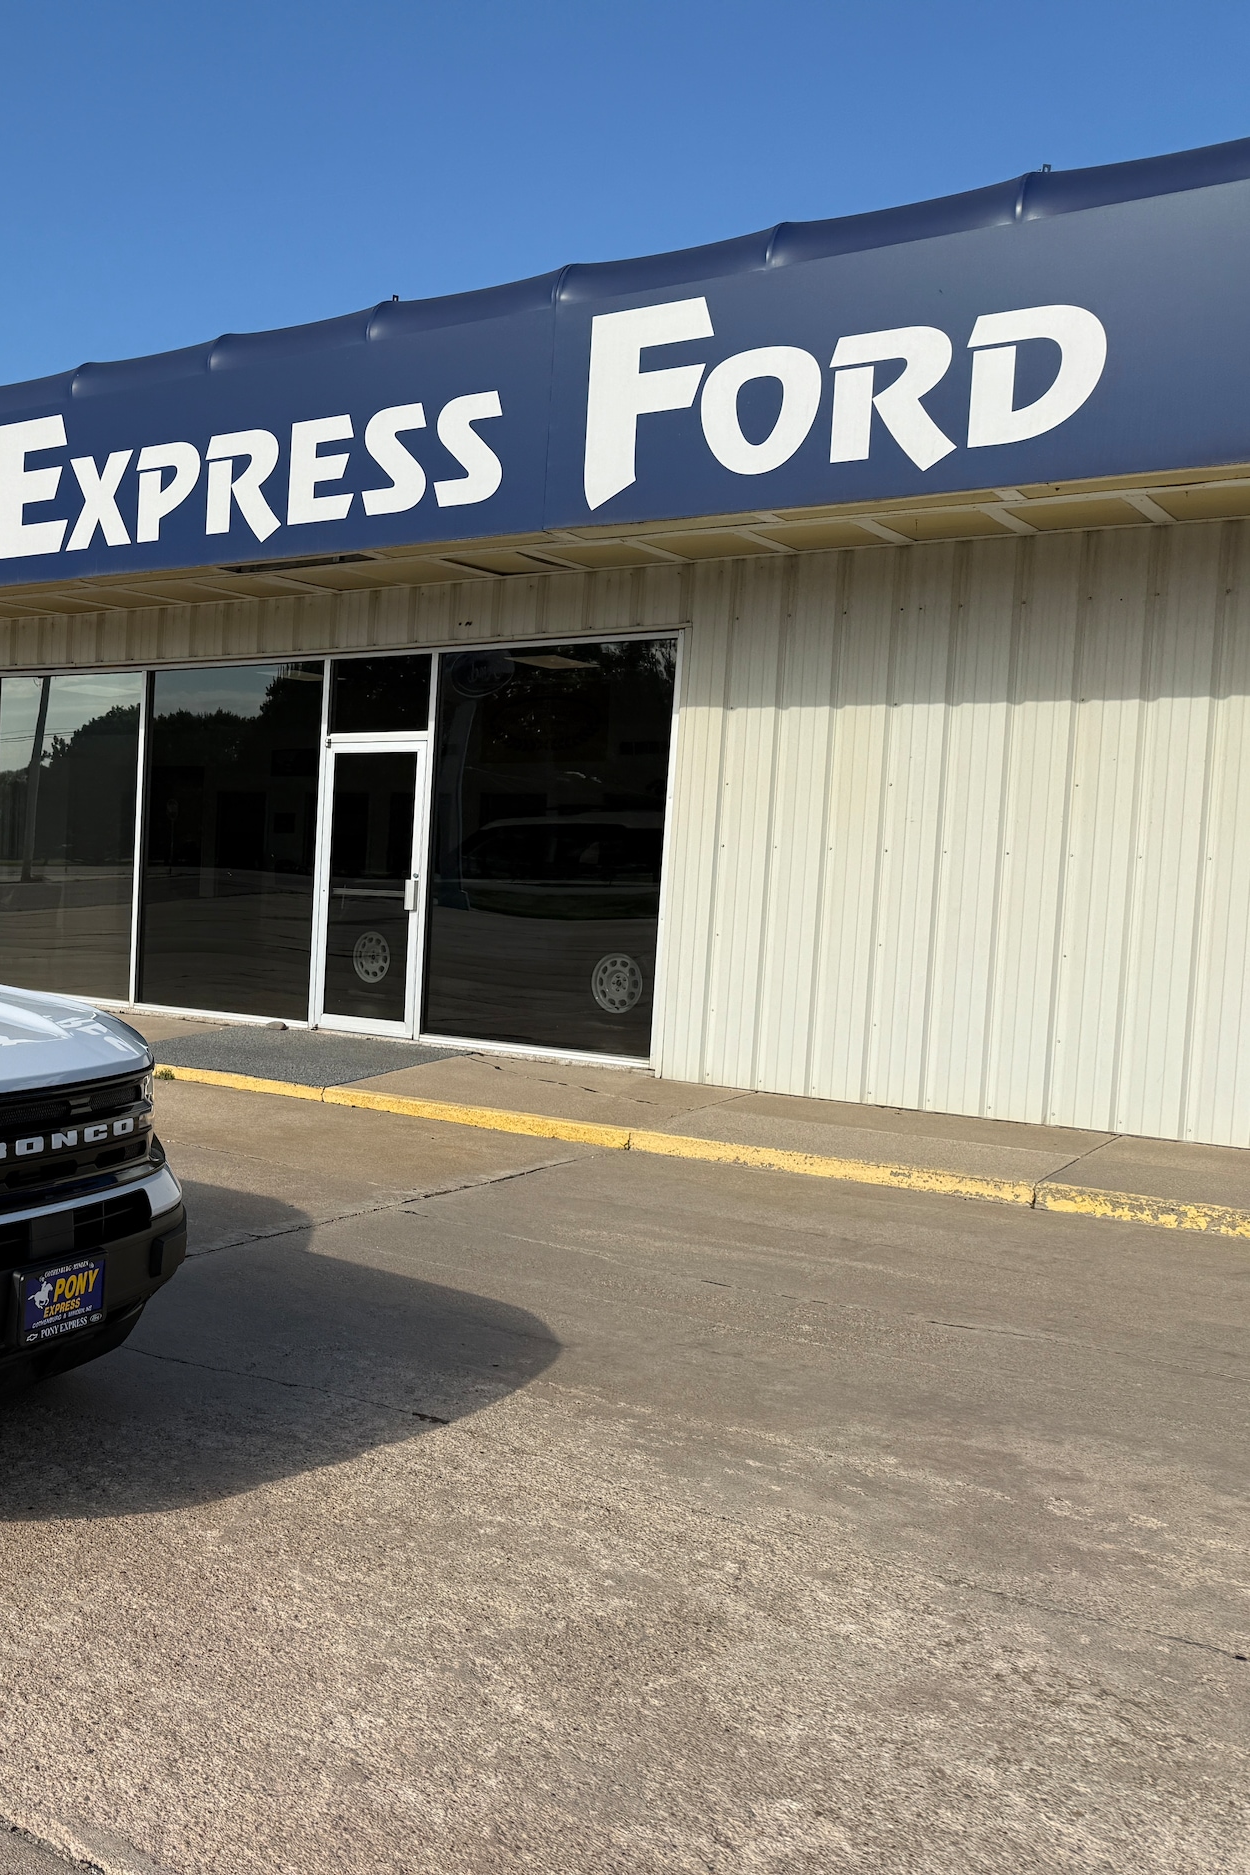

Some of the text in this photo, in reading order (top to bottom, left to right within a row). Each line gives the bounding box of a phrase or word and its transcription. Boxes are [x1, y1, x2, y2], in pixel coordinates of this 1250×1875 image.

[583, 296, 1107, 512] FORD
[53, 1268, 100, 1302] PONY
[43, 1297, 81, 1319] EXPRESS
[40, 1324, 60, 1339] PONY
[59, 1316, 88, 1333] EXPRESS
